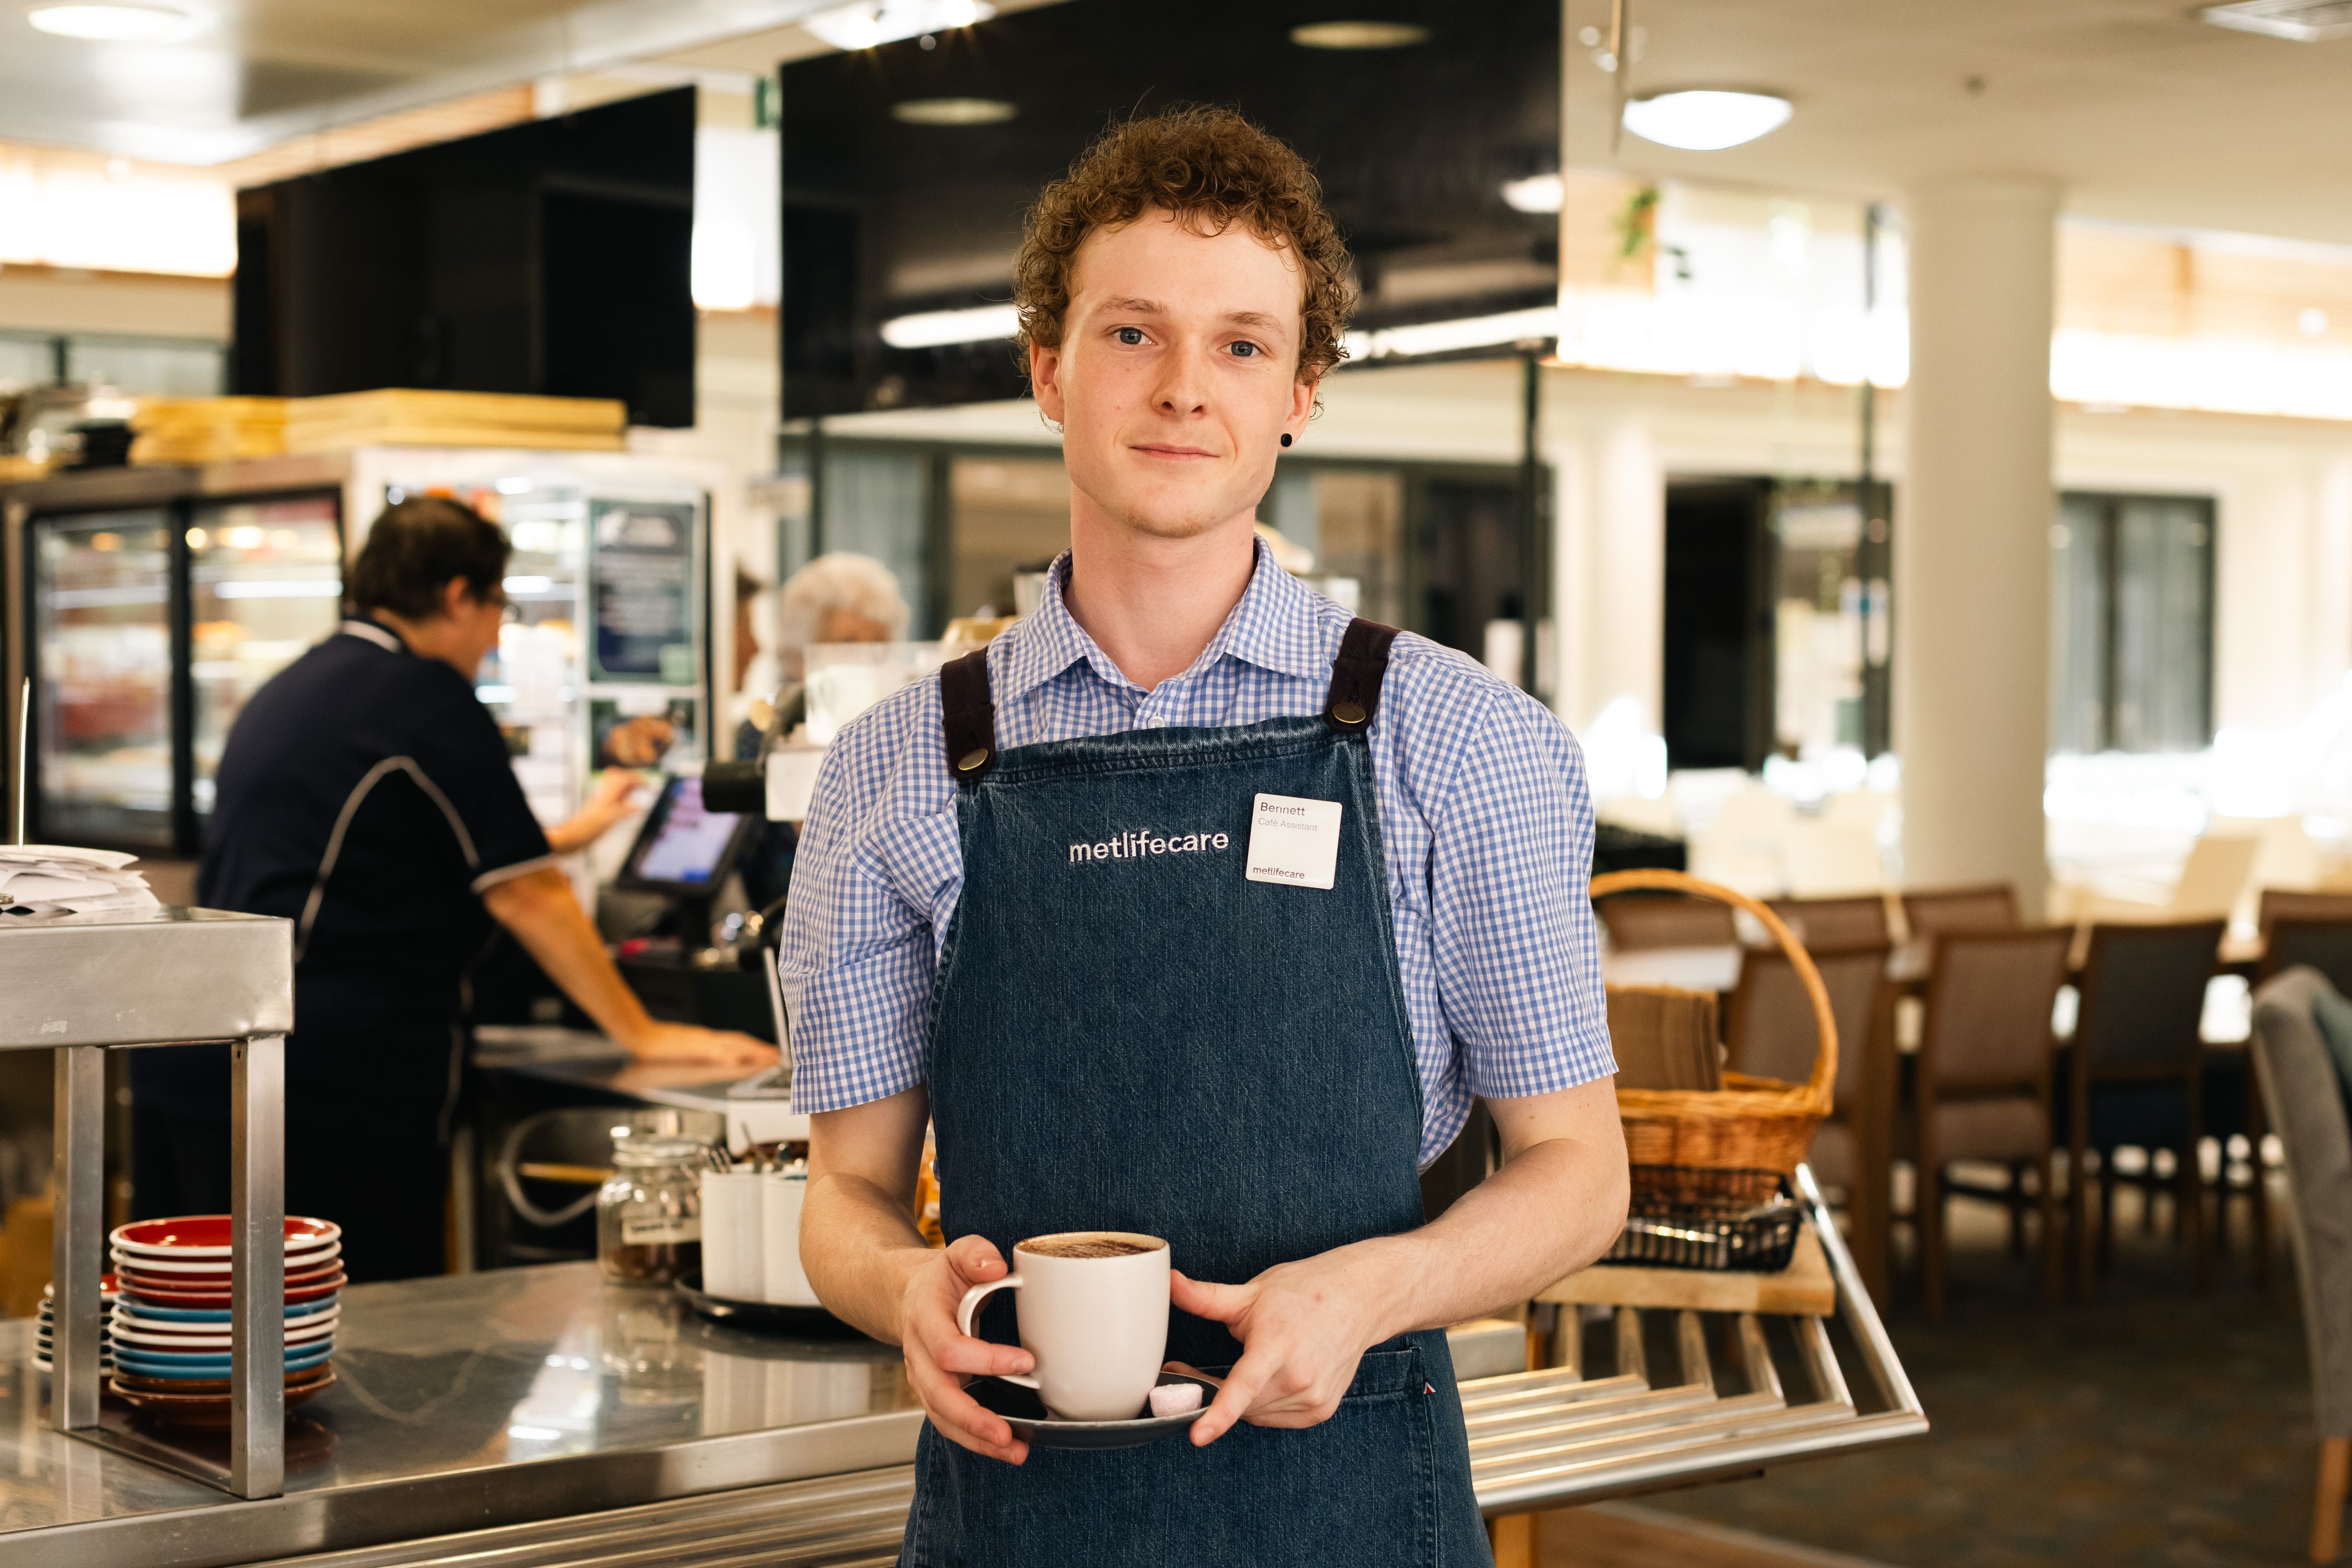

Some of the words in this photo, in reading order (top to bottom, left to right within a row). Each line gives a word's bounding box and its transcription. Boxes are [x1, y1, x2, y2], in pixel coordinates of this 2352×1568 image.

[1260, 802, 1305, 816] Bennett
[1258, 817, 1278, 826] Café
[1280, 820, 1318, 831] Assistant
[1069, 830, 1229, 863] metlifecare
[1253, 867, 1305, 879] metlifecare
